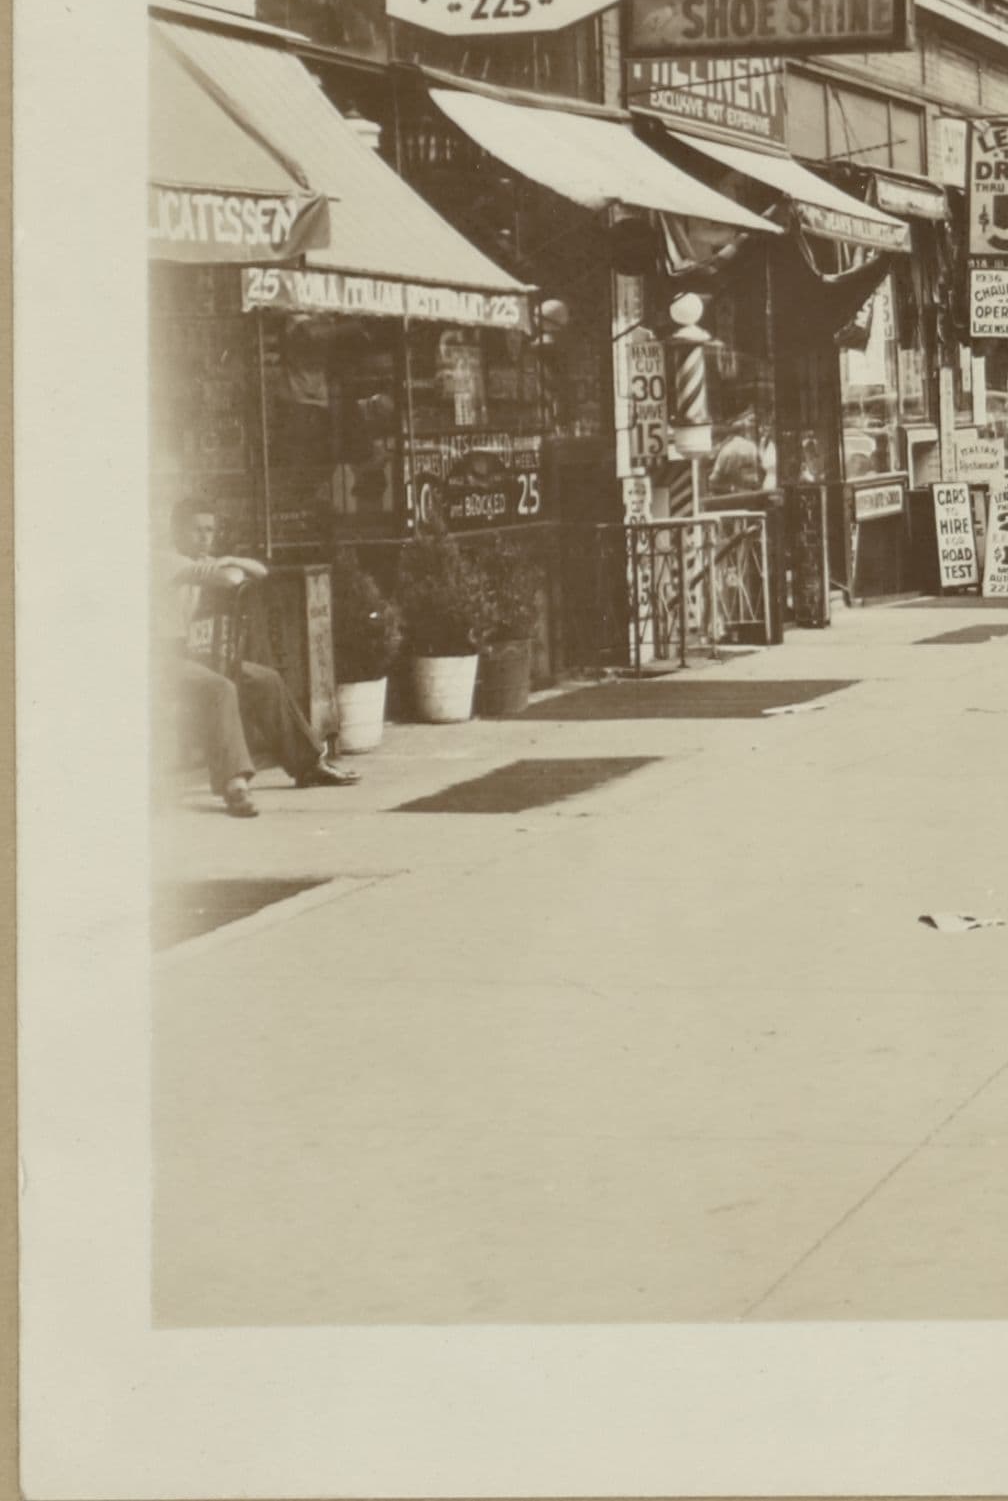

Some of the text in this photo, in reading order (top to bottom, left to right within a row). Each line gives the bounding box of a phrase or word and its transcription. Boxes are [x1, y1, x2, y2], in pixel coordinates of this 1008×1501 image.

[975, 182, 1005, 194] THRU
[635, 360, 662, 373] CUT
[631, 375, 666, 401] 30
[636, 423, 665, 454] 15
[517, 473, 541, 515] 25
[937, 489, 966, 506] CARS
[940, 518, 969, 535] HIRE
[941, 547, 973, 562] ROAD
[944, 565, 973, 580] TEST
